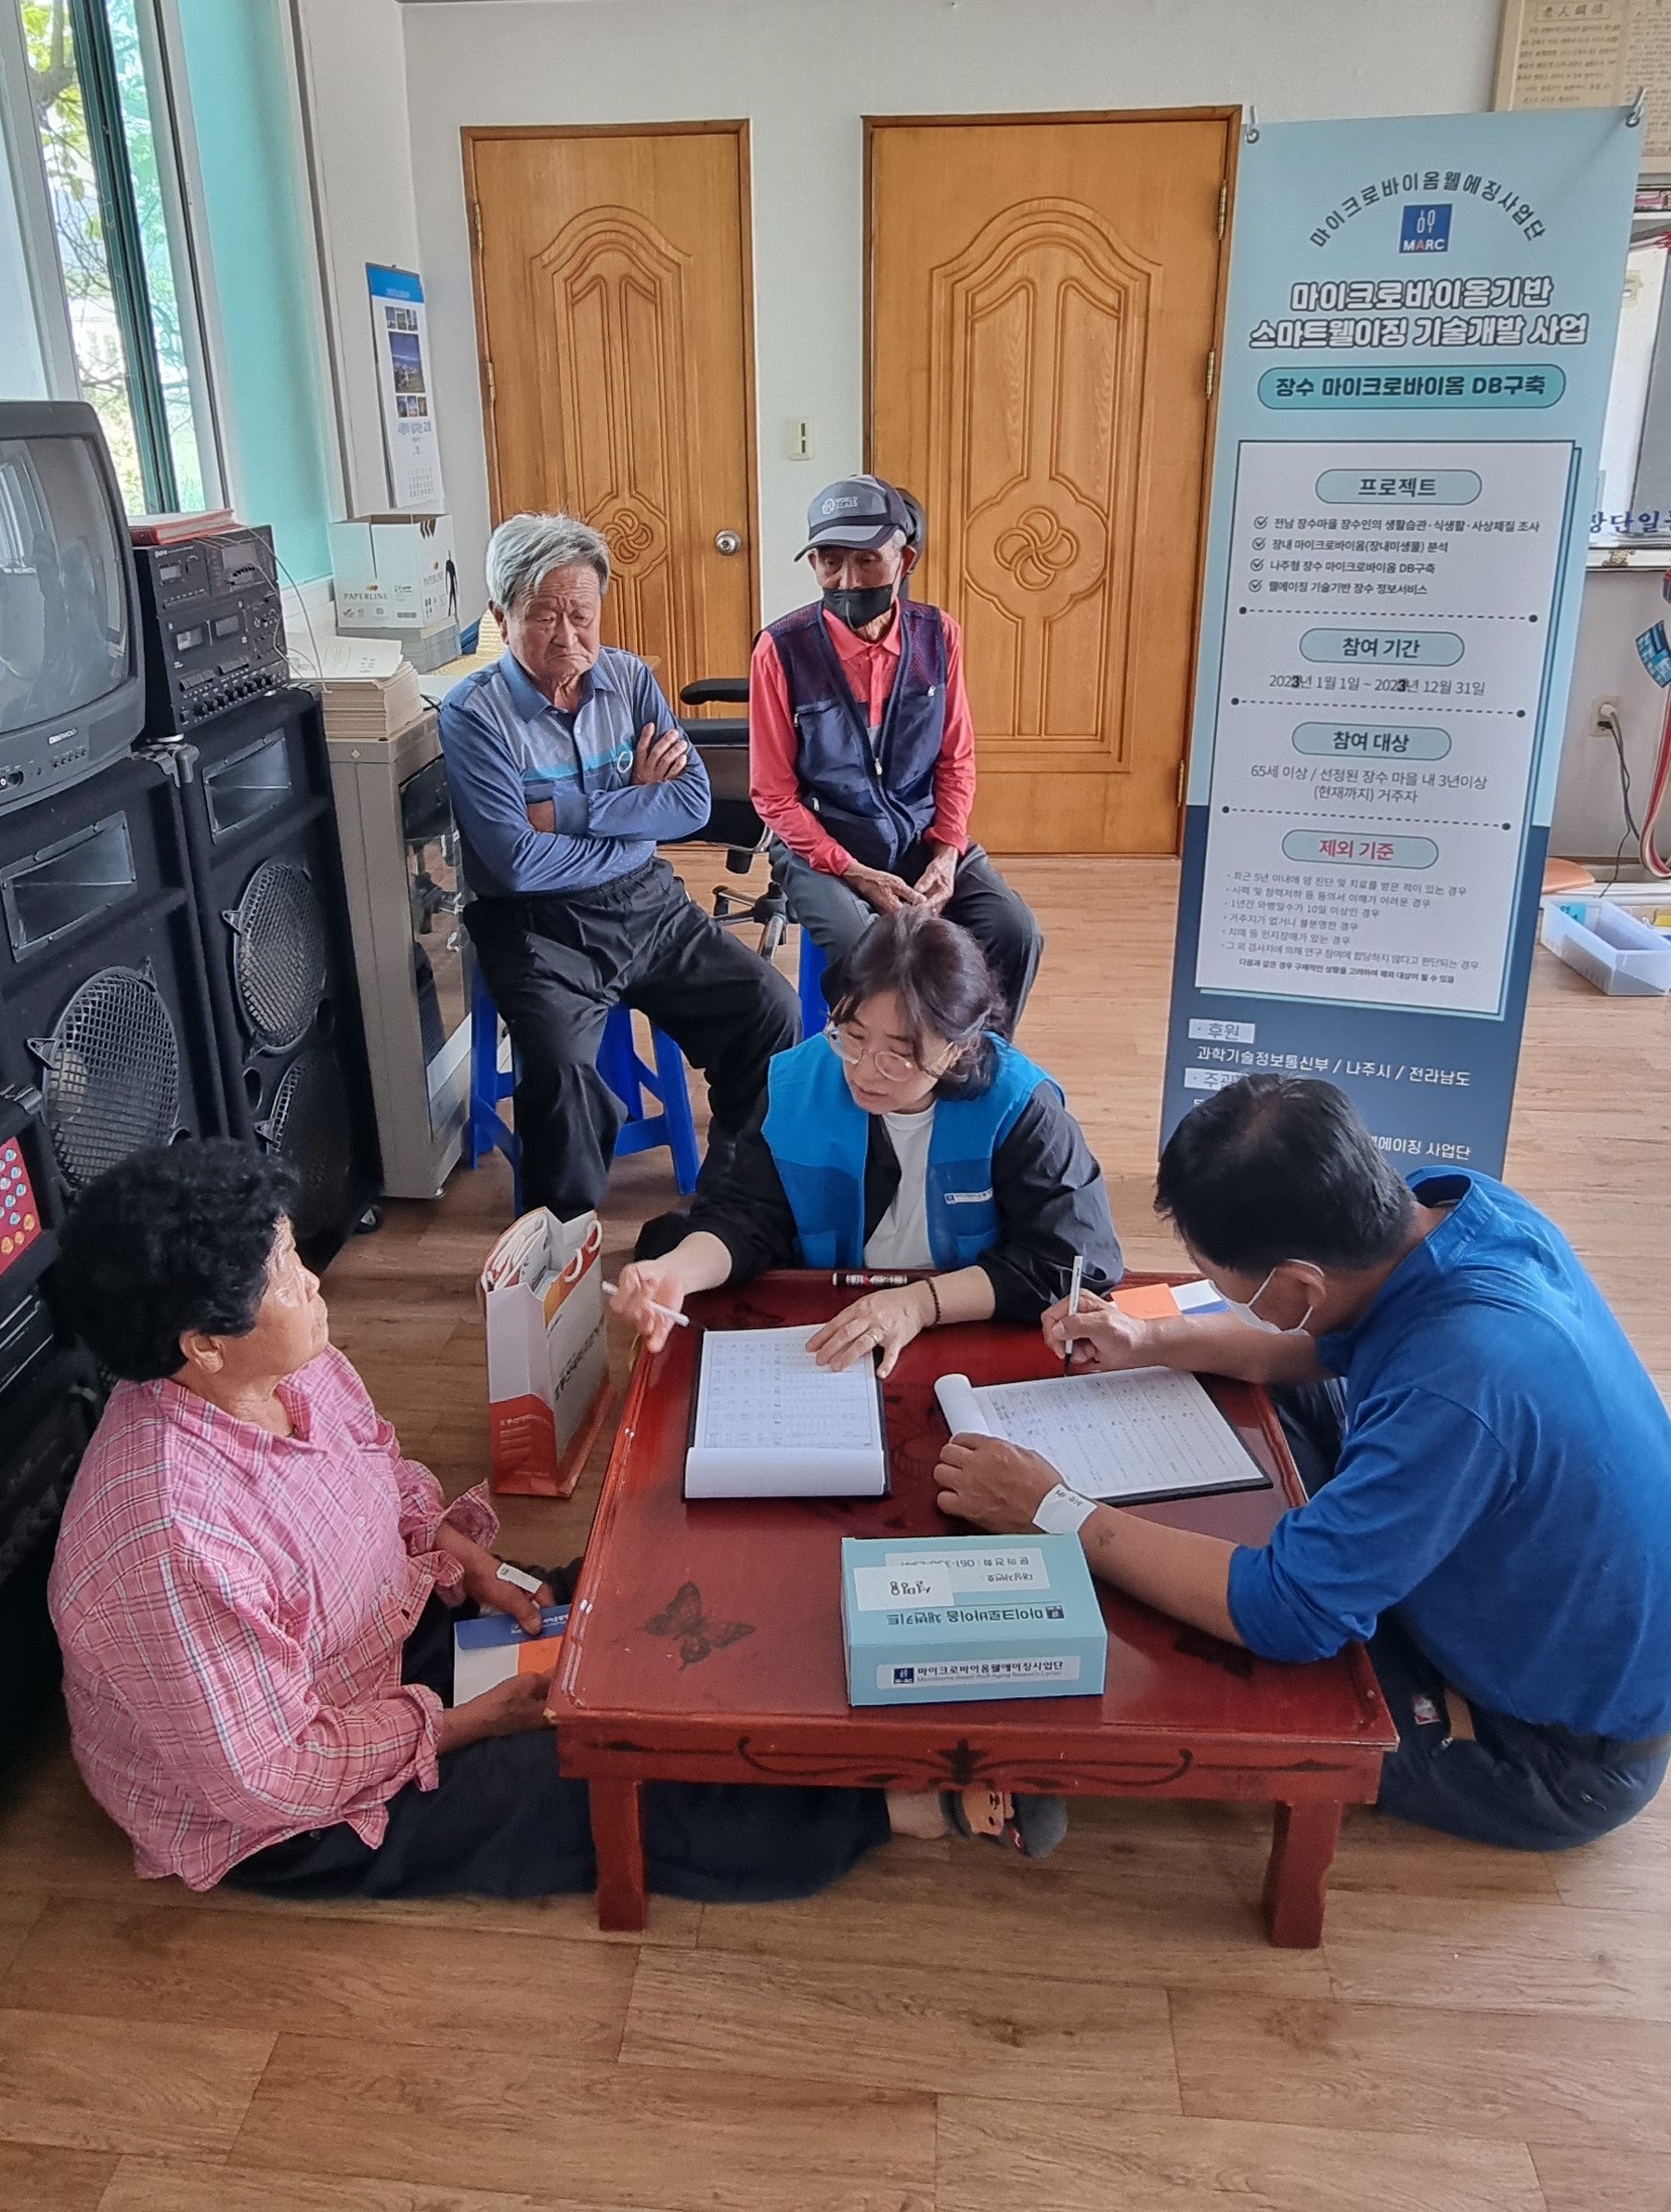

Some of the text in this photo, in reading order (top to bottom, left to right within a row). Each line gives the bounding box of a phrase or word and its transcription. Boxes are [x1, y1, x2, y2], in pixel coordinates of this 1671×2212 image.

[1309, 171, 1547, 248] 마이크로바이옴웰에징사업단
[1403, 239, 1445, 252] MARC
[1290, 277, 1553, 311] 마이크로바이옴기반
[1249, 313, 1589, 348] 스마트웰이징 기술개발 사업
[1276, 375, 1546, 396] 장수 마이크로바이옴 DB구축
[1357, 477, 1437, 498] 프로젝트
[1274, 518, 1294, 530] 전남
[1297, 518, 1338, 530] 장수마을
[1341, 519, 1382, 531] 장수인의
[1517, 521, 1540, 533] 조사
[1272, 539, 1292, 550] 장내
[1427, 542, 1449, 553] 분석
[1270, 560, 1436, 575] 나주형 장수 마이크로바이옴 DB구축
[343, 591, 388, 601] PAPERLINE
[1269, 580, 1429, 596] 웰에이징 기술기반 장수 정보서비스
[1342, 637, 1420, 659] 참여 기간
[1268, 674, 1313, 690] 2023년
[1316, 676, 1337, 691] 1월
[1340, 677, 1360, 692] 1일
[1374, 678, 1419, 694] 2023년
[1423, 679, 1452, 695] 12월
[1456, 680, 1485, 696] 31일
[1333, 731, 1410, 754] 참여 대상
[1250, 765, 1279, 779] 65세
[1282, 766, 1308, 781] 이상
[1320, 768, 1359, 784] 선정된
[1362, 769, 1389, 784] 장수
[1392, 771, 1418, 786] 마을
[1421, 772, 1435, 787] 내
[1438, 774, 1487, 791] 3년이상
[1314, 785, 1418, 804] (현재까지) 거주자
[1319, 839, 1394, 861] 제외 기준
[1253, 873, 1269, 883] 5년
[1272, 873, 1300, 885] 이내에
[1315, 876, 1334, 887] 진단
[1425, 884, 1444, 896] 있는
[1448, 886, 1468, 897] 경우
[1231, 899, 1254, 910] 1년간
[1307, 904, 1327, 914] 10일
[1329, 907, 1358, 918] 이상인
[1361, 908, 1380, 919] 경우
[1380, 895, 1408, 907] 어려운
[1412, 898, 1431, 909] 경우
[1340, 921, 1359, 932] 경우
[1310, 933, 1328, 944] 있는
[1332, 935, 1350, 946] 경우
[1304, 947, 1323, 957] 연구
[1460, 959, 1479, 971] 경우
[1207, 1022, 1240, 1041] 후원
[1197, 1045, 1329, 1073] 과학기술정보통신부
[1346, 1060, 1392, 1080] 나주시
[1408, 1067, 1471, 1087] 전라남도
[1425, 1142, 1471, 1160] 사업단
[885, 1607, 1043, 1626] 마이크로바이옴 채변키트
